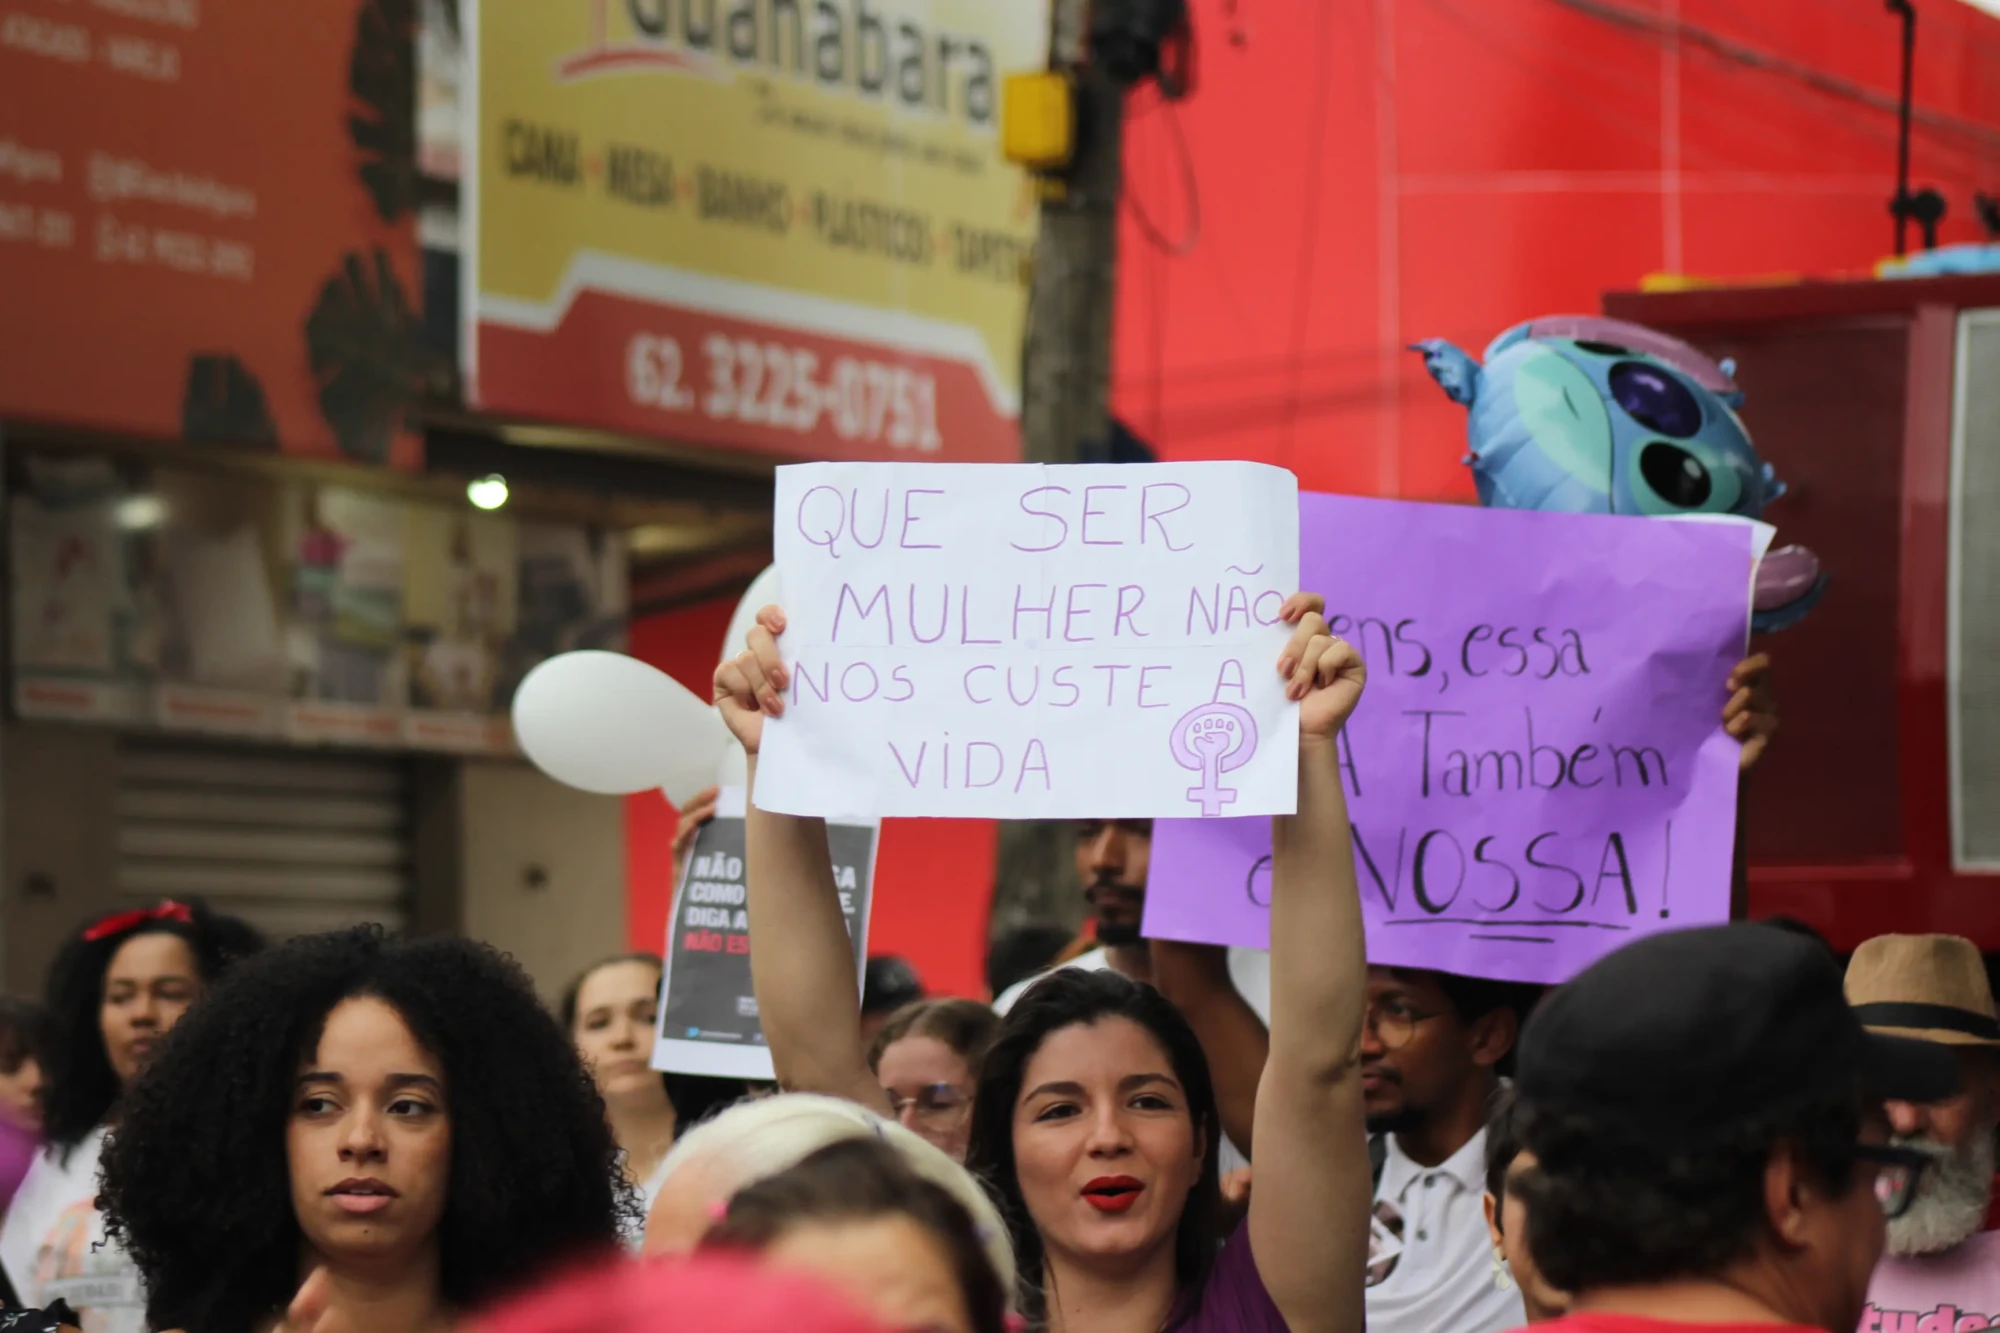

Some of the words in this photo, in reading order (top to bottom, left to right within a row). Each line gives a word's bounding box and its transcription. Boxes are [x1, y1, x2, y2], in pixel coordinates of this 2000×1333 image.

[798, 486, 945, 558] QUE
[1010, 483, 1194, 552] SER
[831, 583, 1150, 645] MULHER
[1186, 563, 1285, 636] NÃO
[1462, 623, 1591, 678] essa
[792, 661, 915, 703] NOS
[962, 665, 1172, 708] CUSTE
[1212, 658, 1247, 703] A
[1402, 706, 1669, 798] Também
[694, 851, 742, 880] NÃO
[685, 906, 730, 928] DIGA
[689, 882, 745, 905] COMO
[684, 930, 723, 952] NÃO
